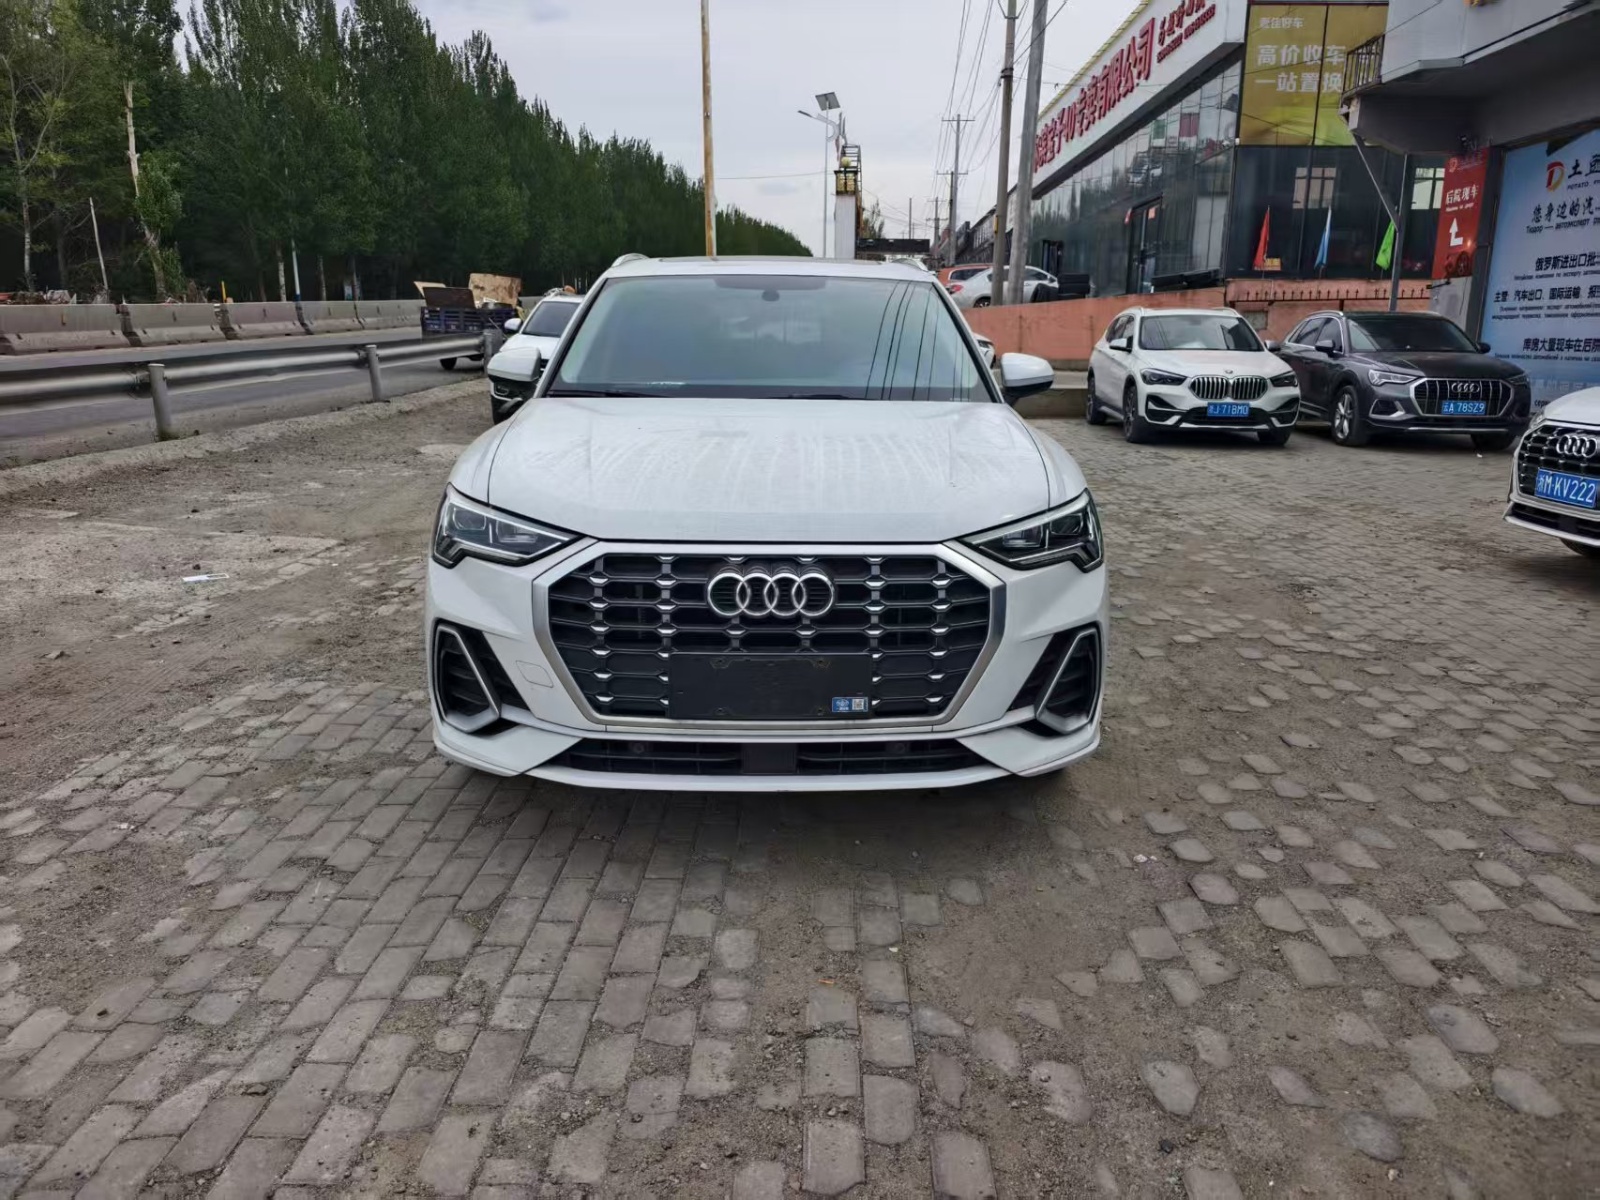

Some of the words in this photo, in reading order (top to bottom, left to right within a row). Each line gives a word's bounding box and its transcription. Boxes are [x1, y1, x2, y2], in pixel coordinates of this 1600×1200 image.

[1257, 44, 1346, 66] 高价收车
[1255, 72, 1342, 93] 一站置换
[1531, 196, 1600, 223] 您身边的汽
